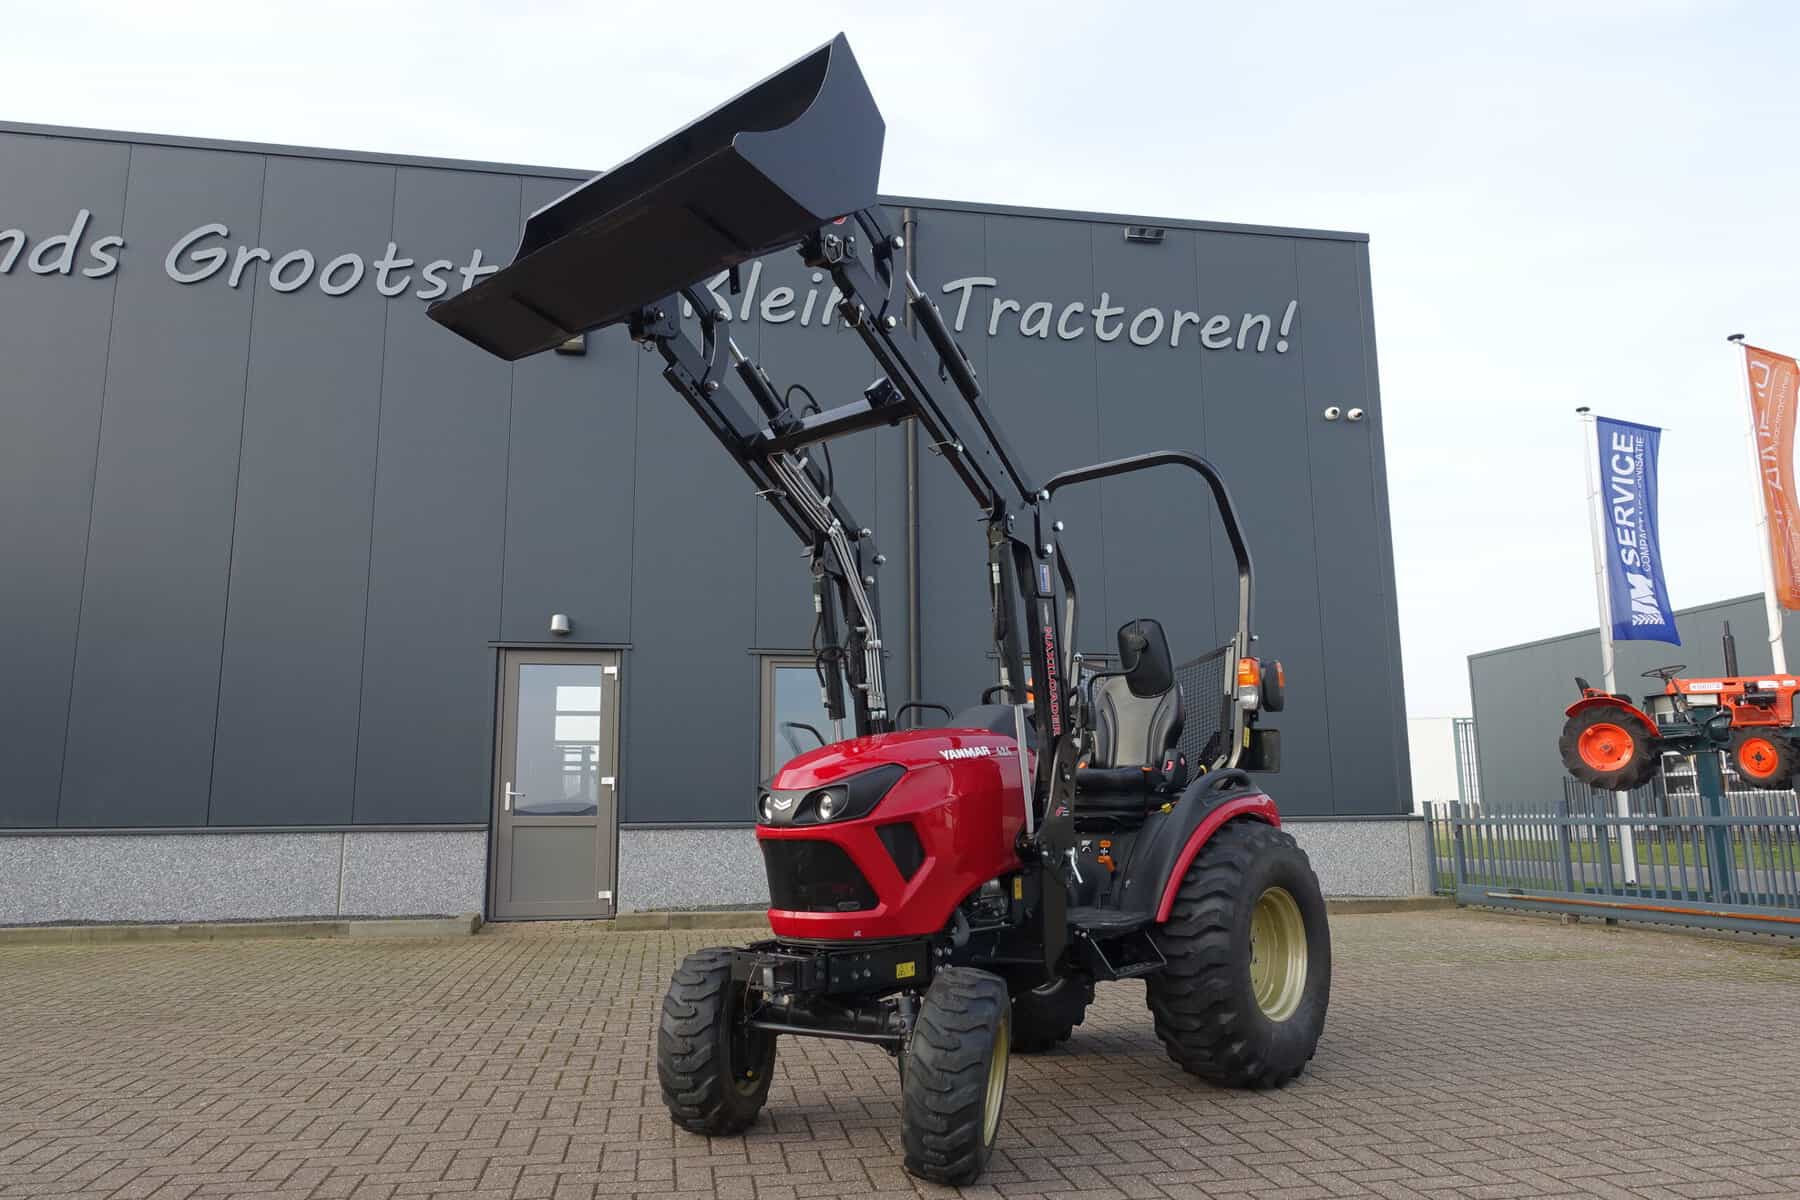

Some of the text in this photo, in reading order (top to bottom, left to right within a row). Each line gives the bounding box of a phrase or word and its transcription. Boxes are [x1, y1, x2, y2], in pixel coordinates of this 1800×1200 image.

[942, 275, 1298, 354] Tractoren!
[1611, 431, 1641, 568] SERVICE
[1044, 626, 1060, 736] MAXILOADER
[938, 745, 991, 761] YANMAR
